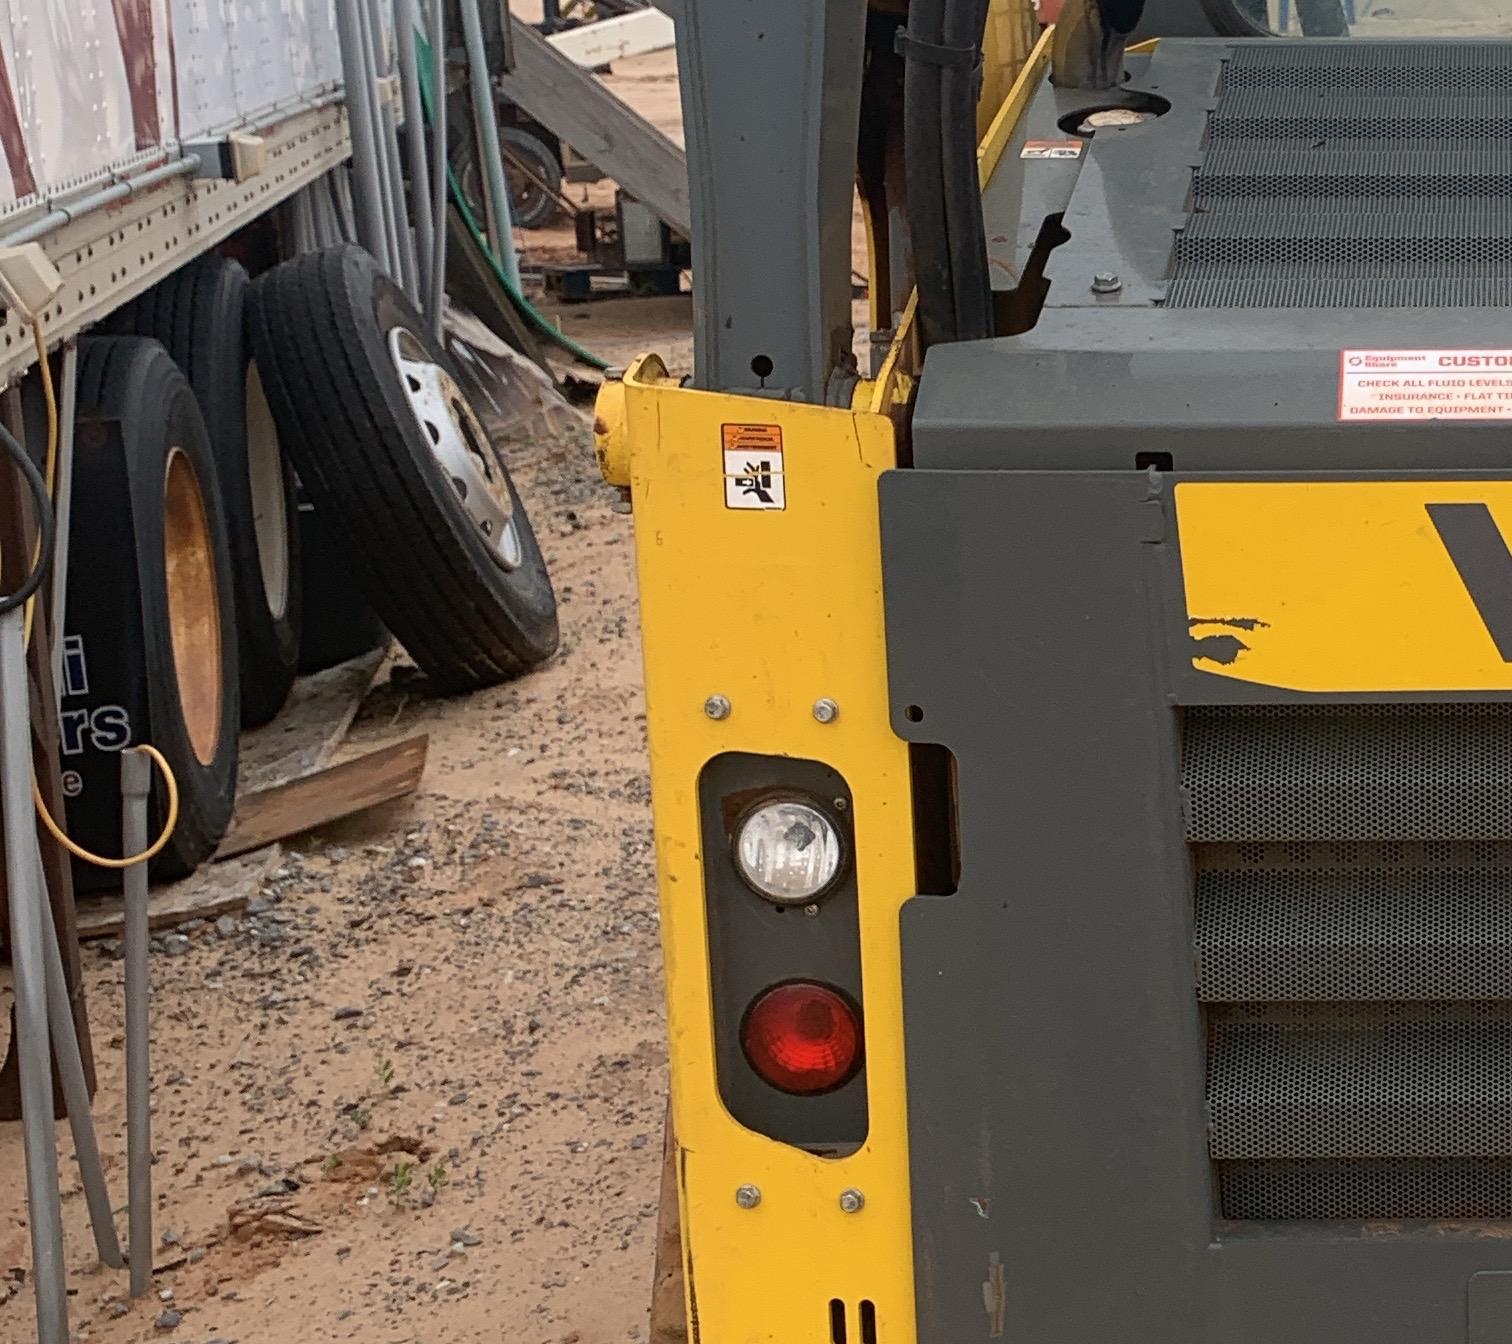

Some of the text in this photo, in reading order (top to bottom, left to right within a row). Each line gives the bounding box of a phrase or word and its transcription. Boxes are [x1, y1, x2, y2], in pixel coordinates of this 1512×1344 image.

[1357, 379, 1400, 388] CHECK
[1403, 379, 1425, 387] ALL
[1428, 379, 1466, 388] FLUID
[1378, 392, 1454, 401] INSURANCE
[1464, 392, 1493, 400] FLAT
[1350, 406, 1404, 415] DAMAGE
[1409, 406, 1424, 414] TO
[1427, 405, 1504, 414] EQUIPMENT
[60, 705, 132, 755] rs
